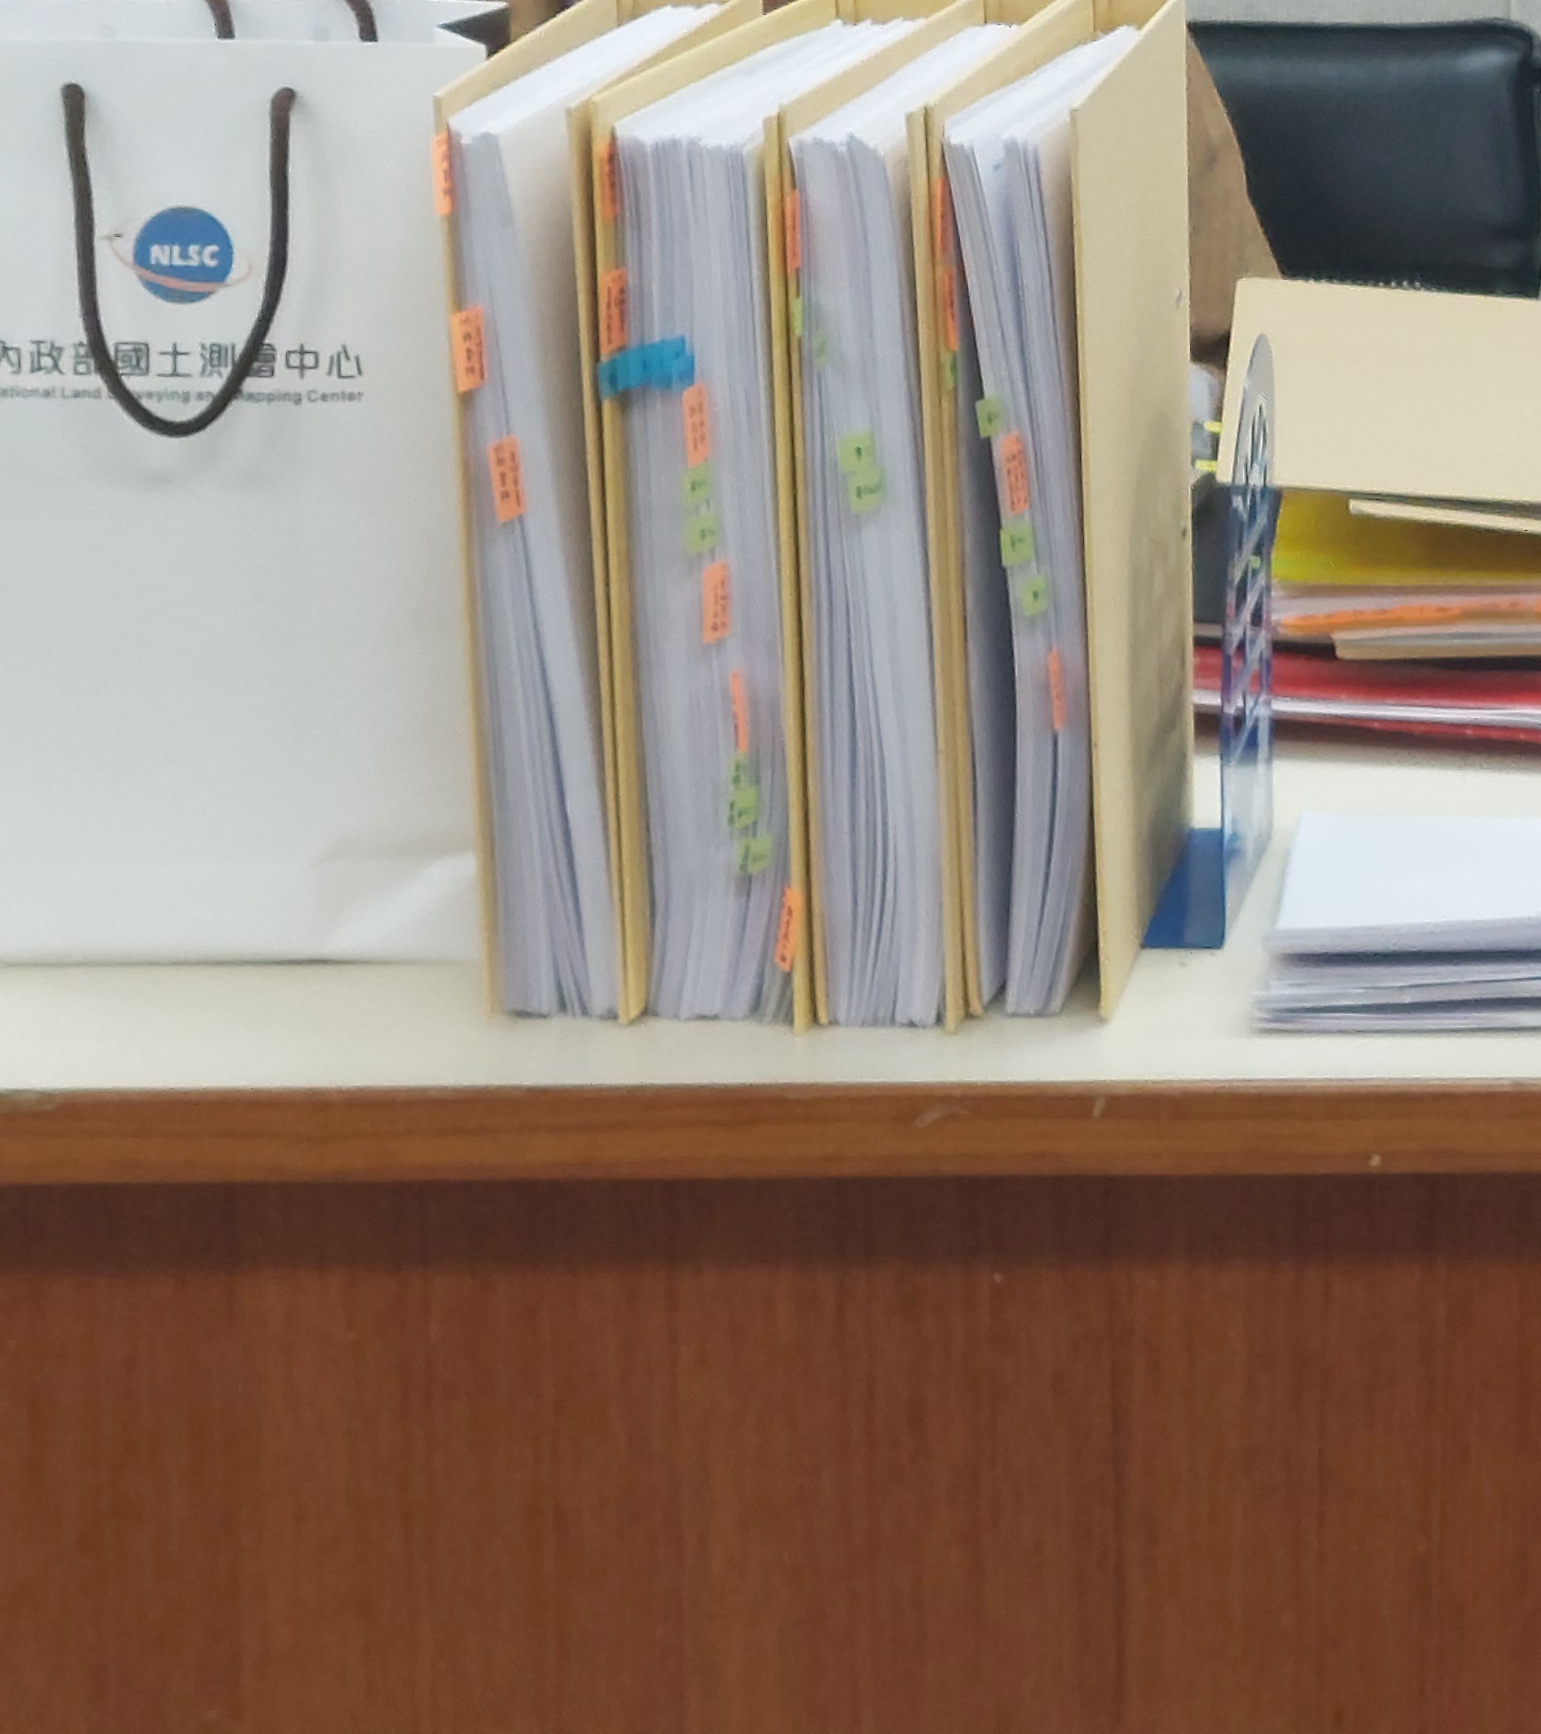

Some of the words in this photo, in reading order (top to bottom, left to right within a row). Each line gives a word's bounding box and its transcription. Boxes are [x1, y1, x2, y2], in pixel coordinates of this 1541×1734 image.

[149, 244, 220, 267] NLSC
[0, 386, 55, 398] ational
[240, 391, 302, 404] apping
[306, 389, 364, 403] Center
